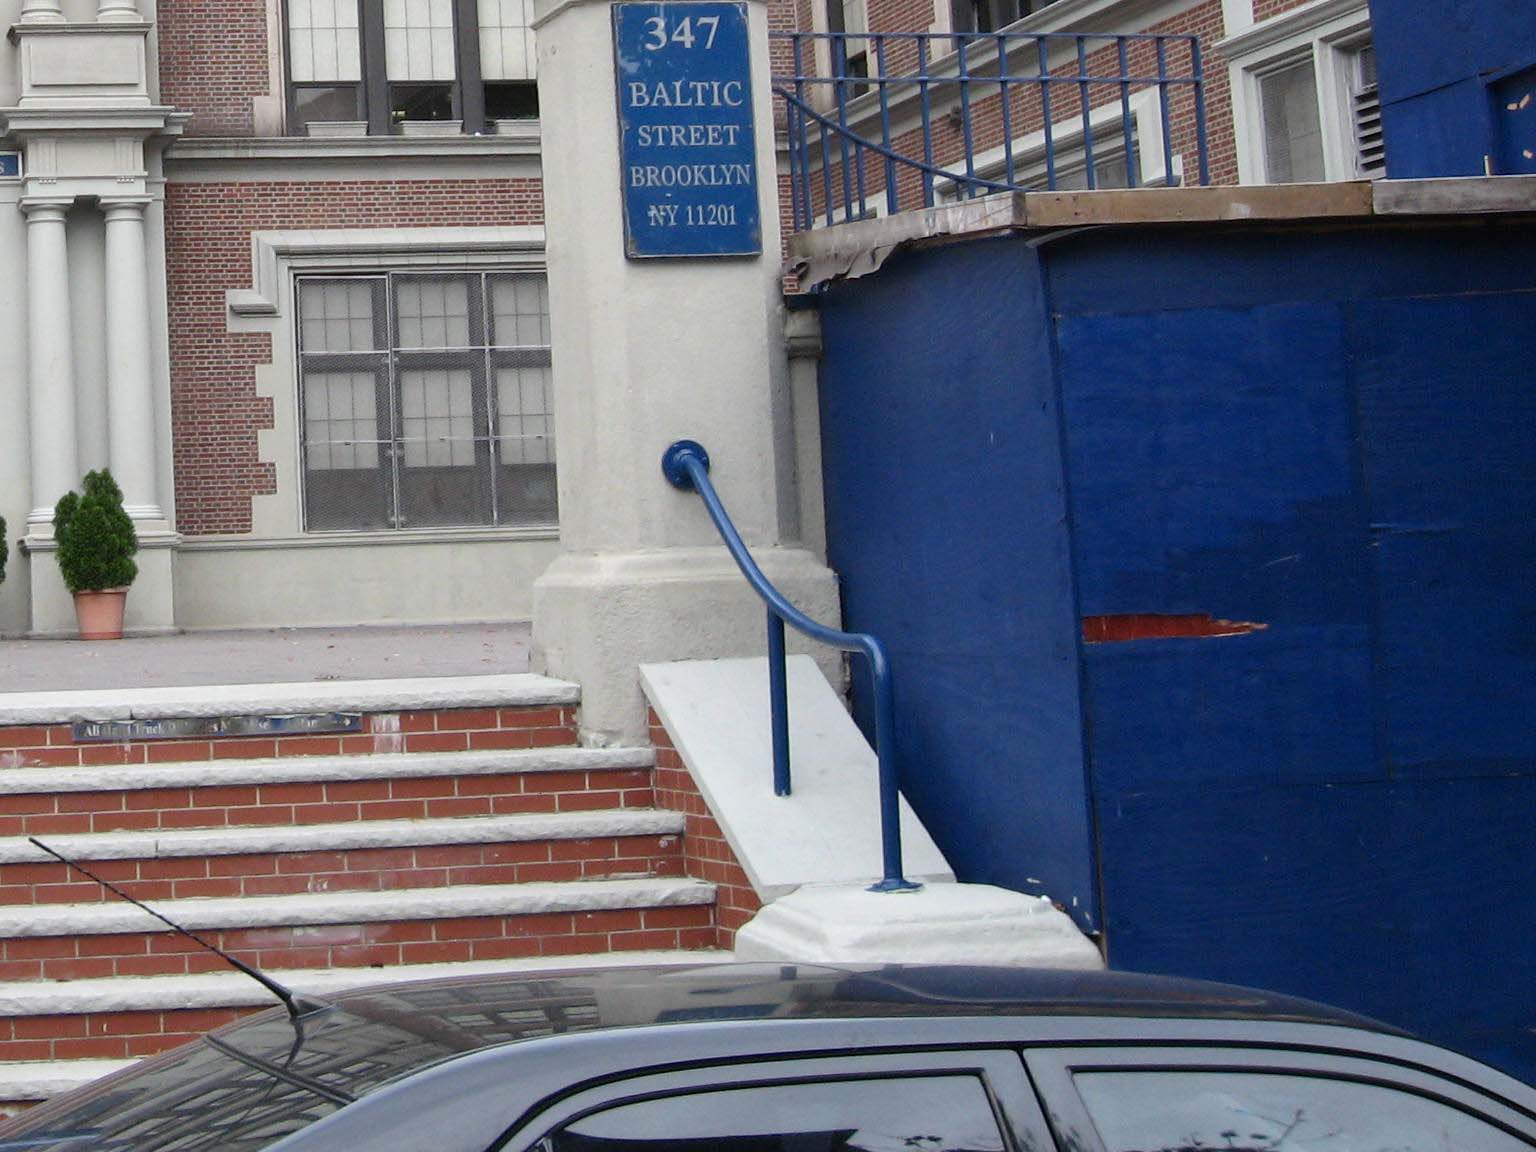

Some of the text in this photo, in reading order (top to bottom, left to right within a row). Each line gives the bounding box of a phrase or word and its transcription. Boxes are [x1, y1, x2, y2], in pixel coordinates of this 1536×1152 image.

[643, 16, 720, 50] 347
[628, 80, 743, 107] BALTIC
[638, 124, 739, 147] STREET
[630, 164, 751, 187] BROOKLYN
[649, 204, 736, 227] NY 11201
